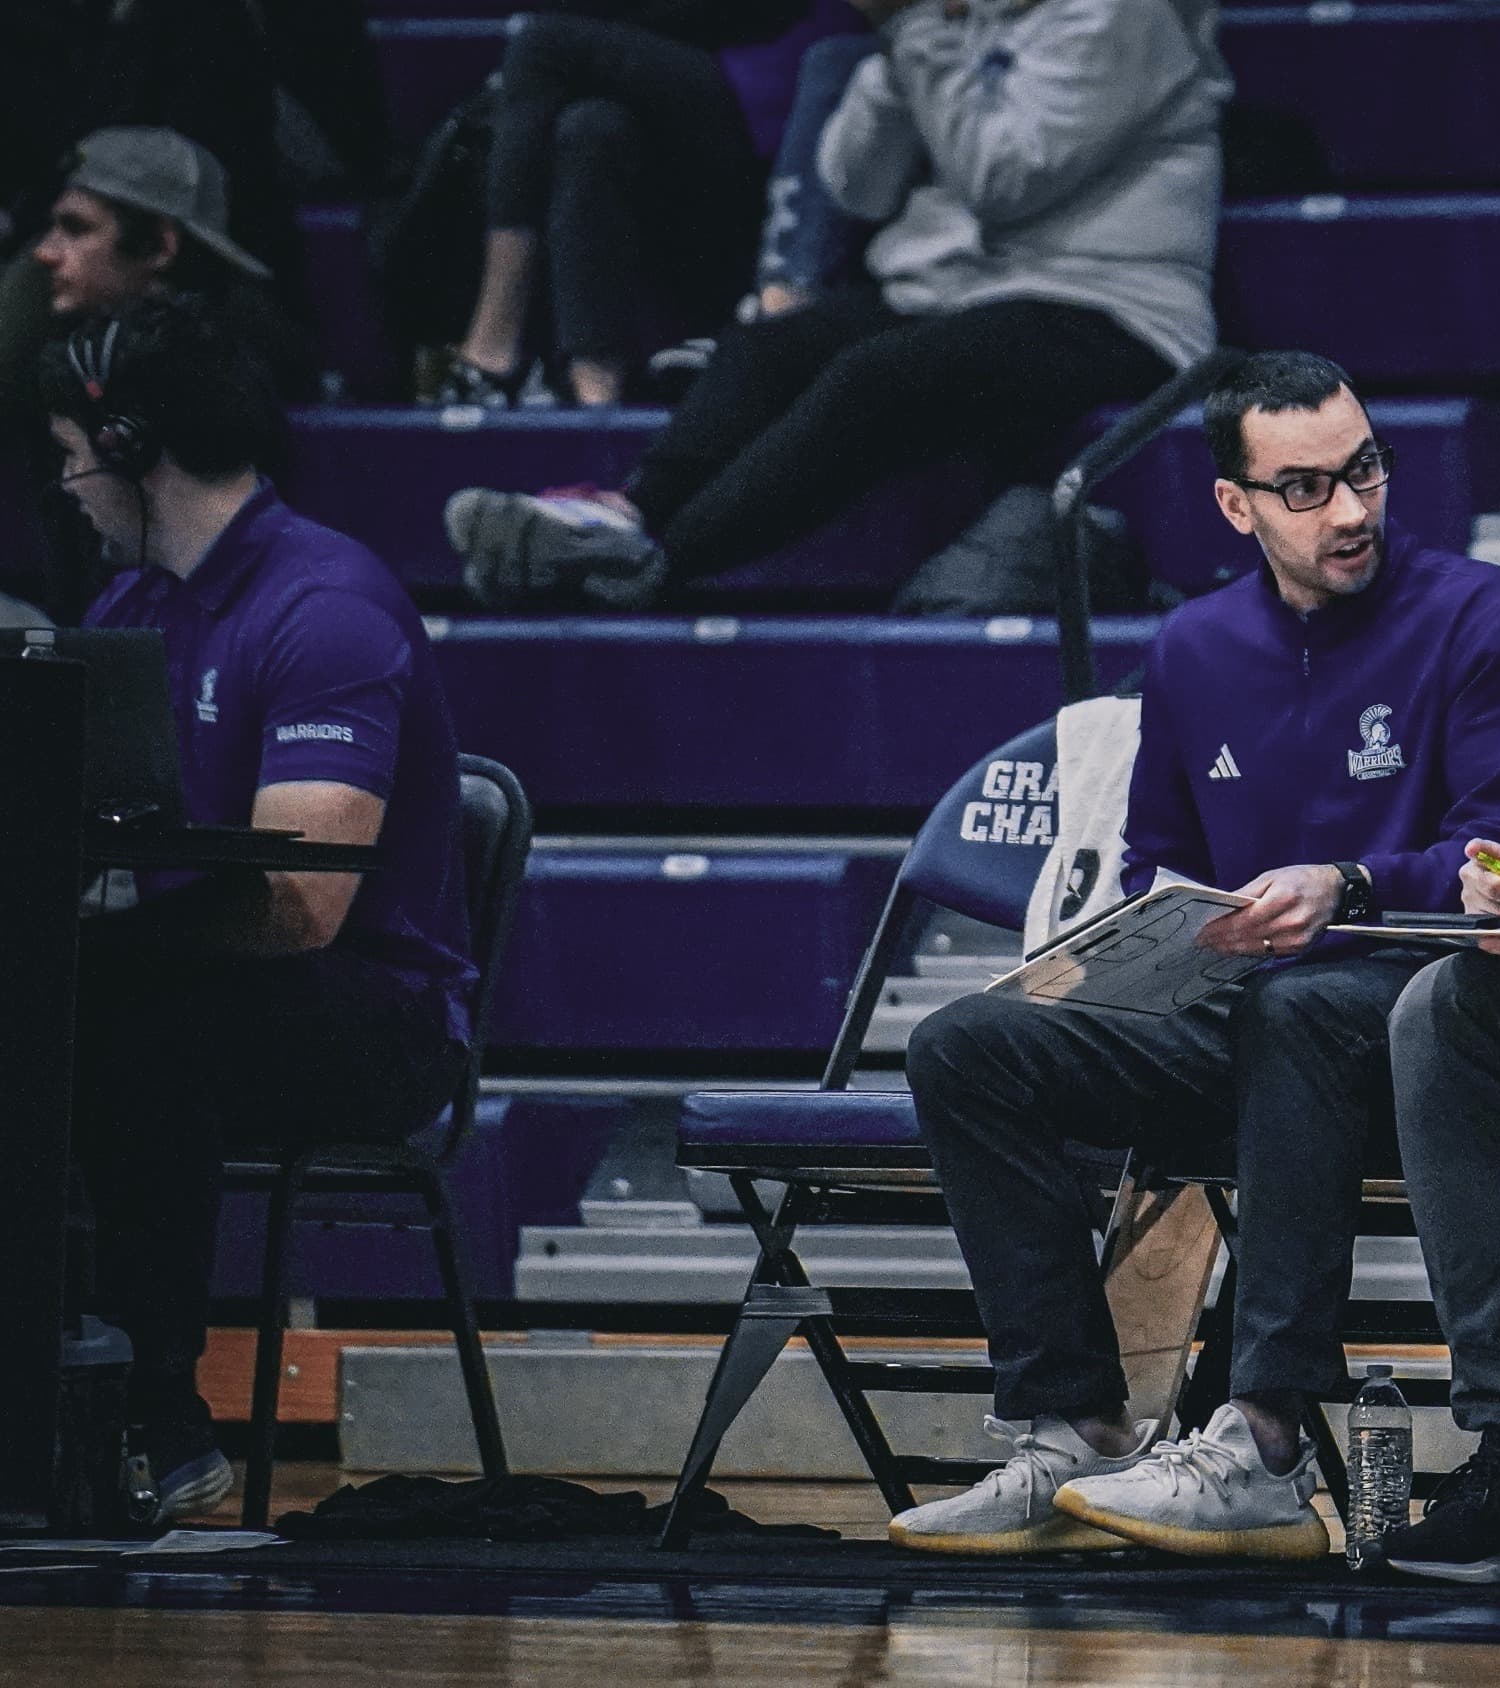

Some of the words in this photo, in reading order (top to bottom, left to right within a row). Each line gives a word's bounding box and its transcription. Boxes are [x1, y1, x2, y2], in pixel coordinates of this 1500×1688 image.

[277, 723, 354, 743] WARRIORS
[1348, 744, 1406, 777] WARRIORS
[983, 760, 1059, 801] GRA
[960, 801, 1054, 845] CHA
